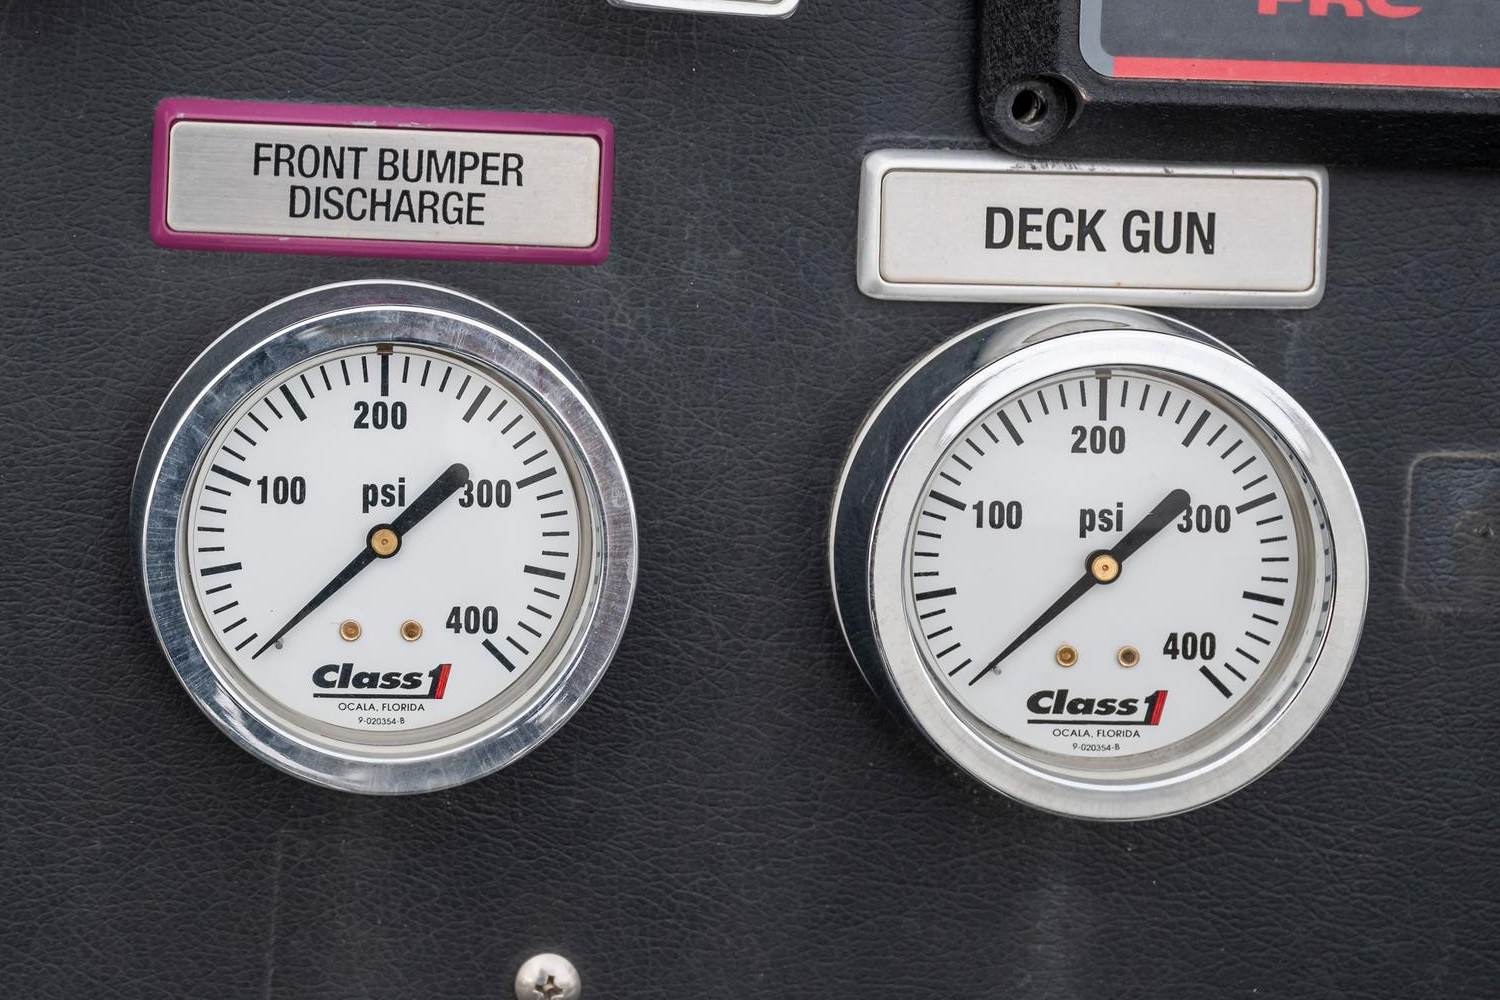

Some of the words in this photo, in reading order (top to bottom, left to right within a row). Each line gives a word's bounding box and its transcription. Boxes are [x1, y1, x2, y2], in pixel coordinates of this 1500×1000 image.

[253, 142, 368, 179] FRONT
[377, 148, 524, 187] BUMPER
[289, 185, 486, 226] DISCHARGE
[984, 206, 1107, 252] DECK
[1122, 209, 1216, 255] GUN
[353, 401, 407, 430] 200
[1071, 425, 1125, 454] 200
[257, 476, 306, 505] 100
[362, 477, 406, 513] psi
[458, 479, 512, 508] 300
[972, 501, 1022, 529] 100
[1079, 502, 1124, 538] psi
[1177, 504, 1231, 533] 300
[445, 606, 498, 634] 400
[1163, 632, 1216, 660] 400
[338, 702, 379, 712] OCALA,
[382, 703, 425, 711] FLORIDA
[1053, 728, 1093, 738] OCALA,
[1097, 729, 1140, 738] FLORIDA
